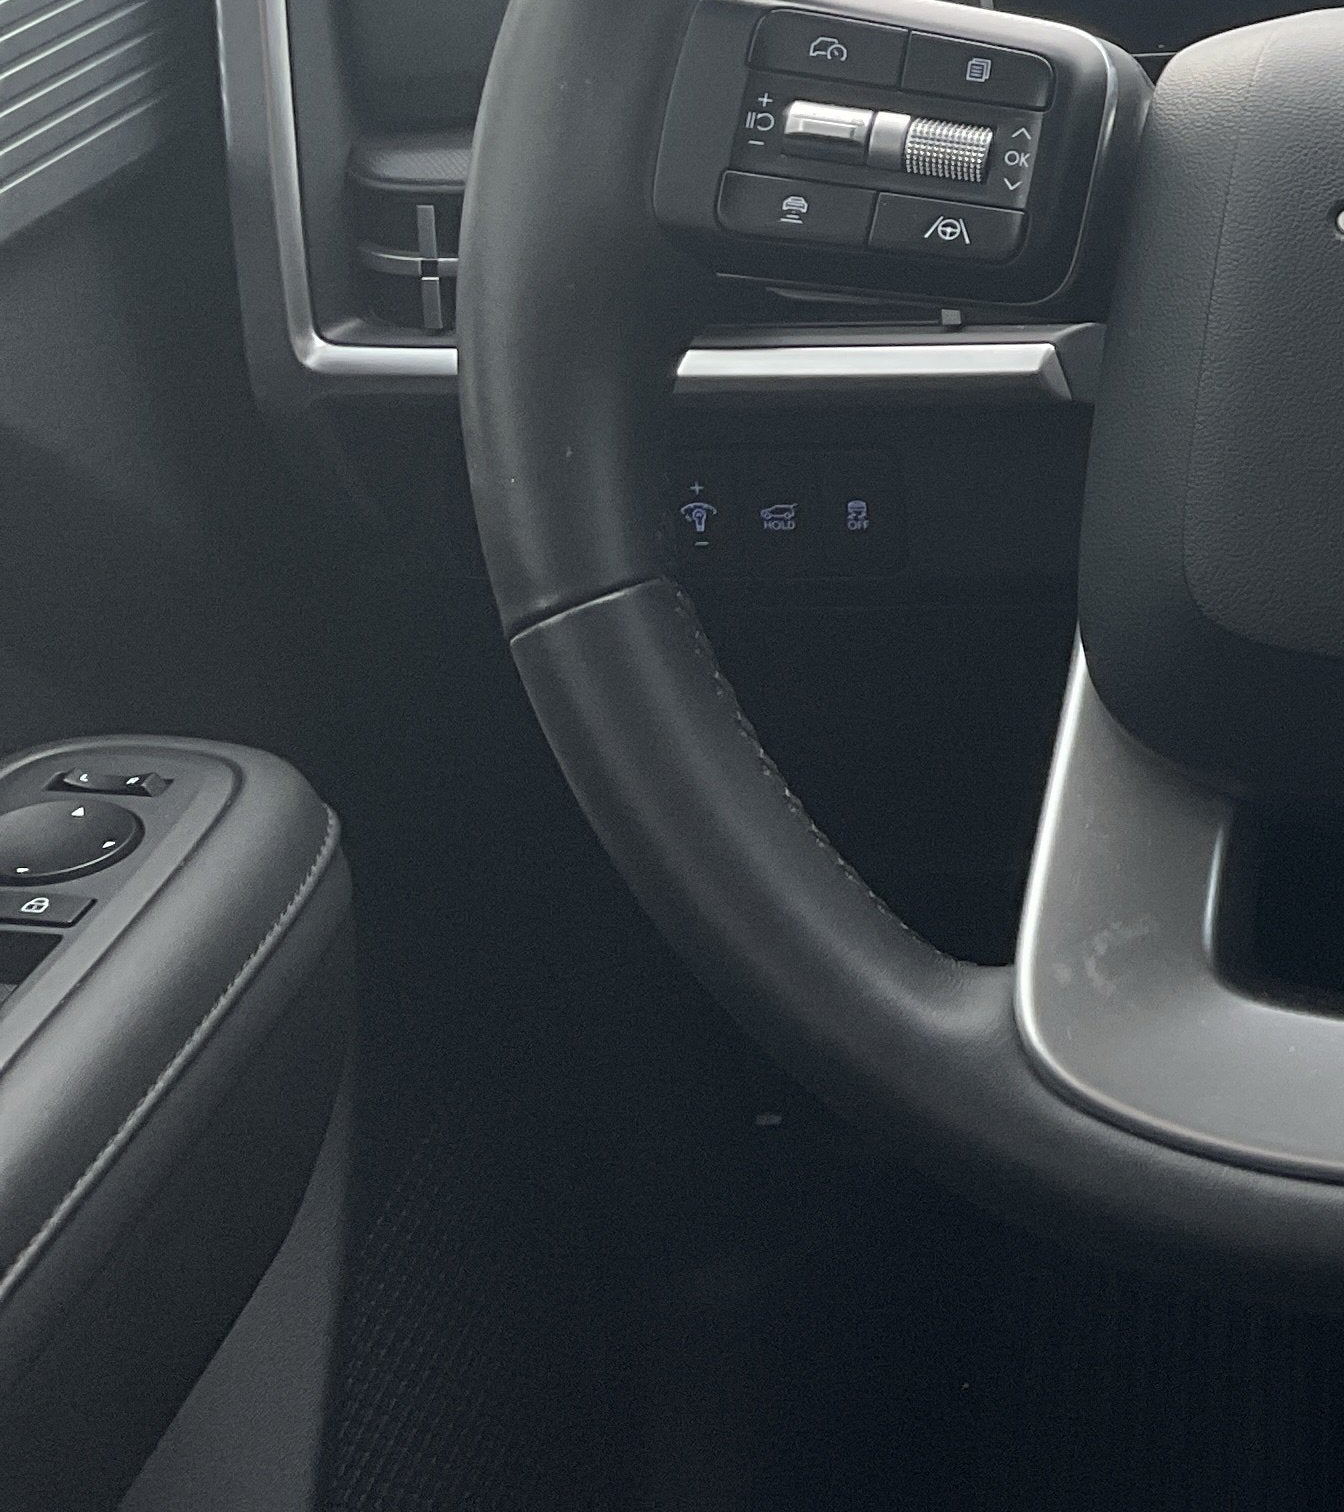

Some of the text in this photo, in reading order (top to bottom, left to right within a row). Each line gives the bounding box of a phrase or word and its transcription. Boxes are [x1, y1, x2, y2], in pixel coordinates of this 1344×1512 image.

[1004, 150, 1031, 168] OK
[763, 520, 796, 531] HOLD
[847, 520, 870, 531] OFF
